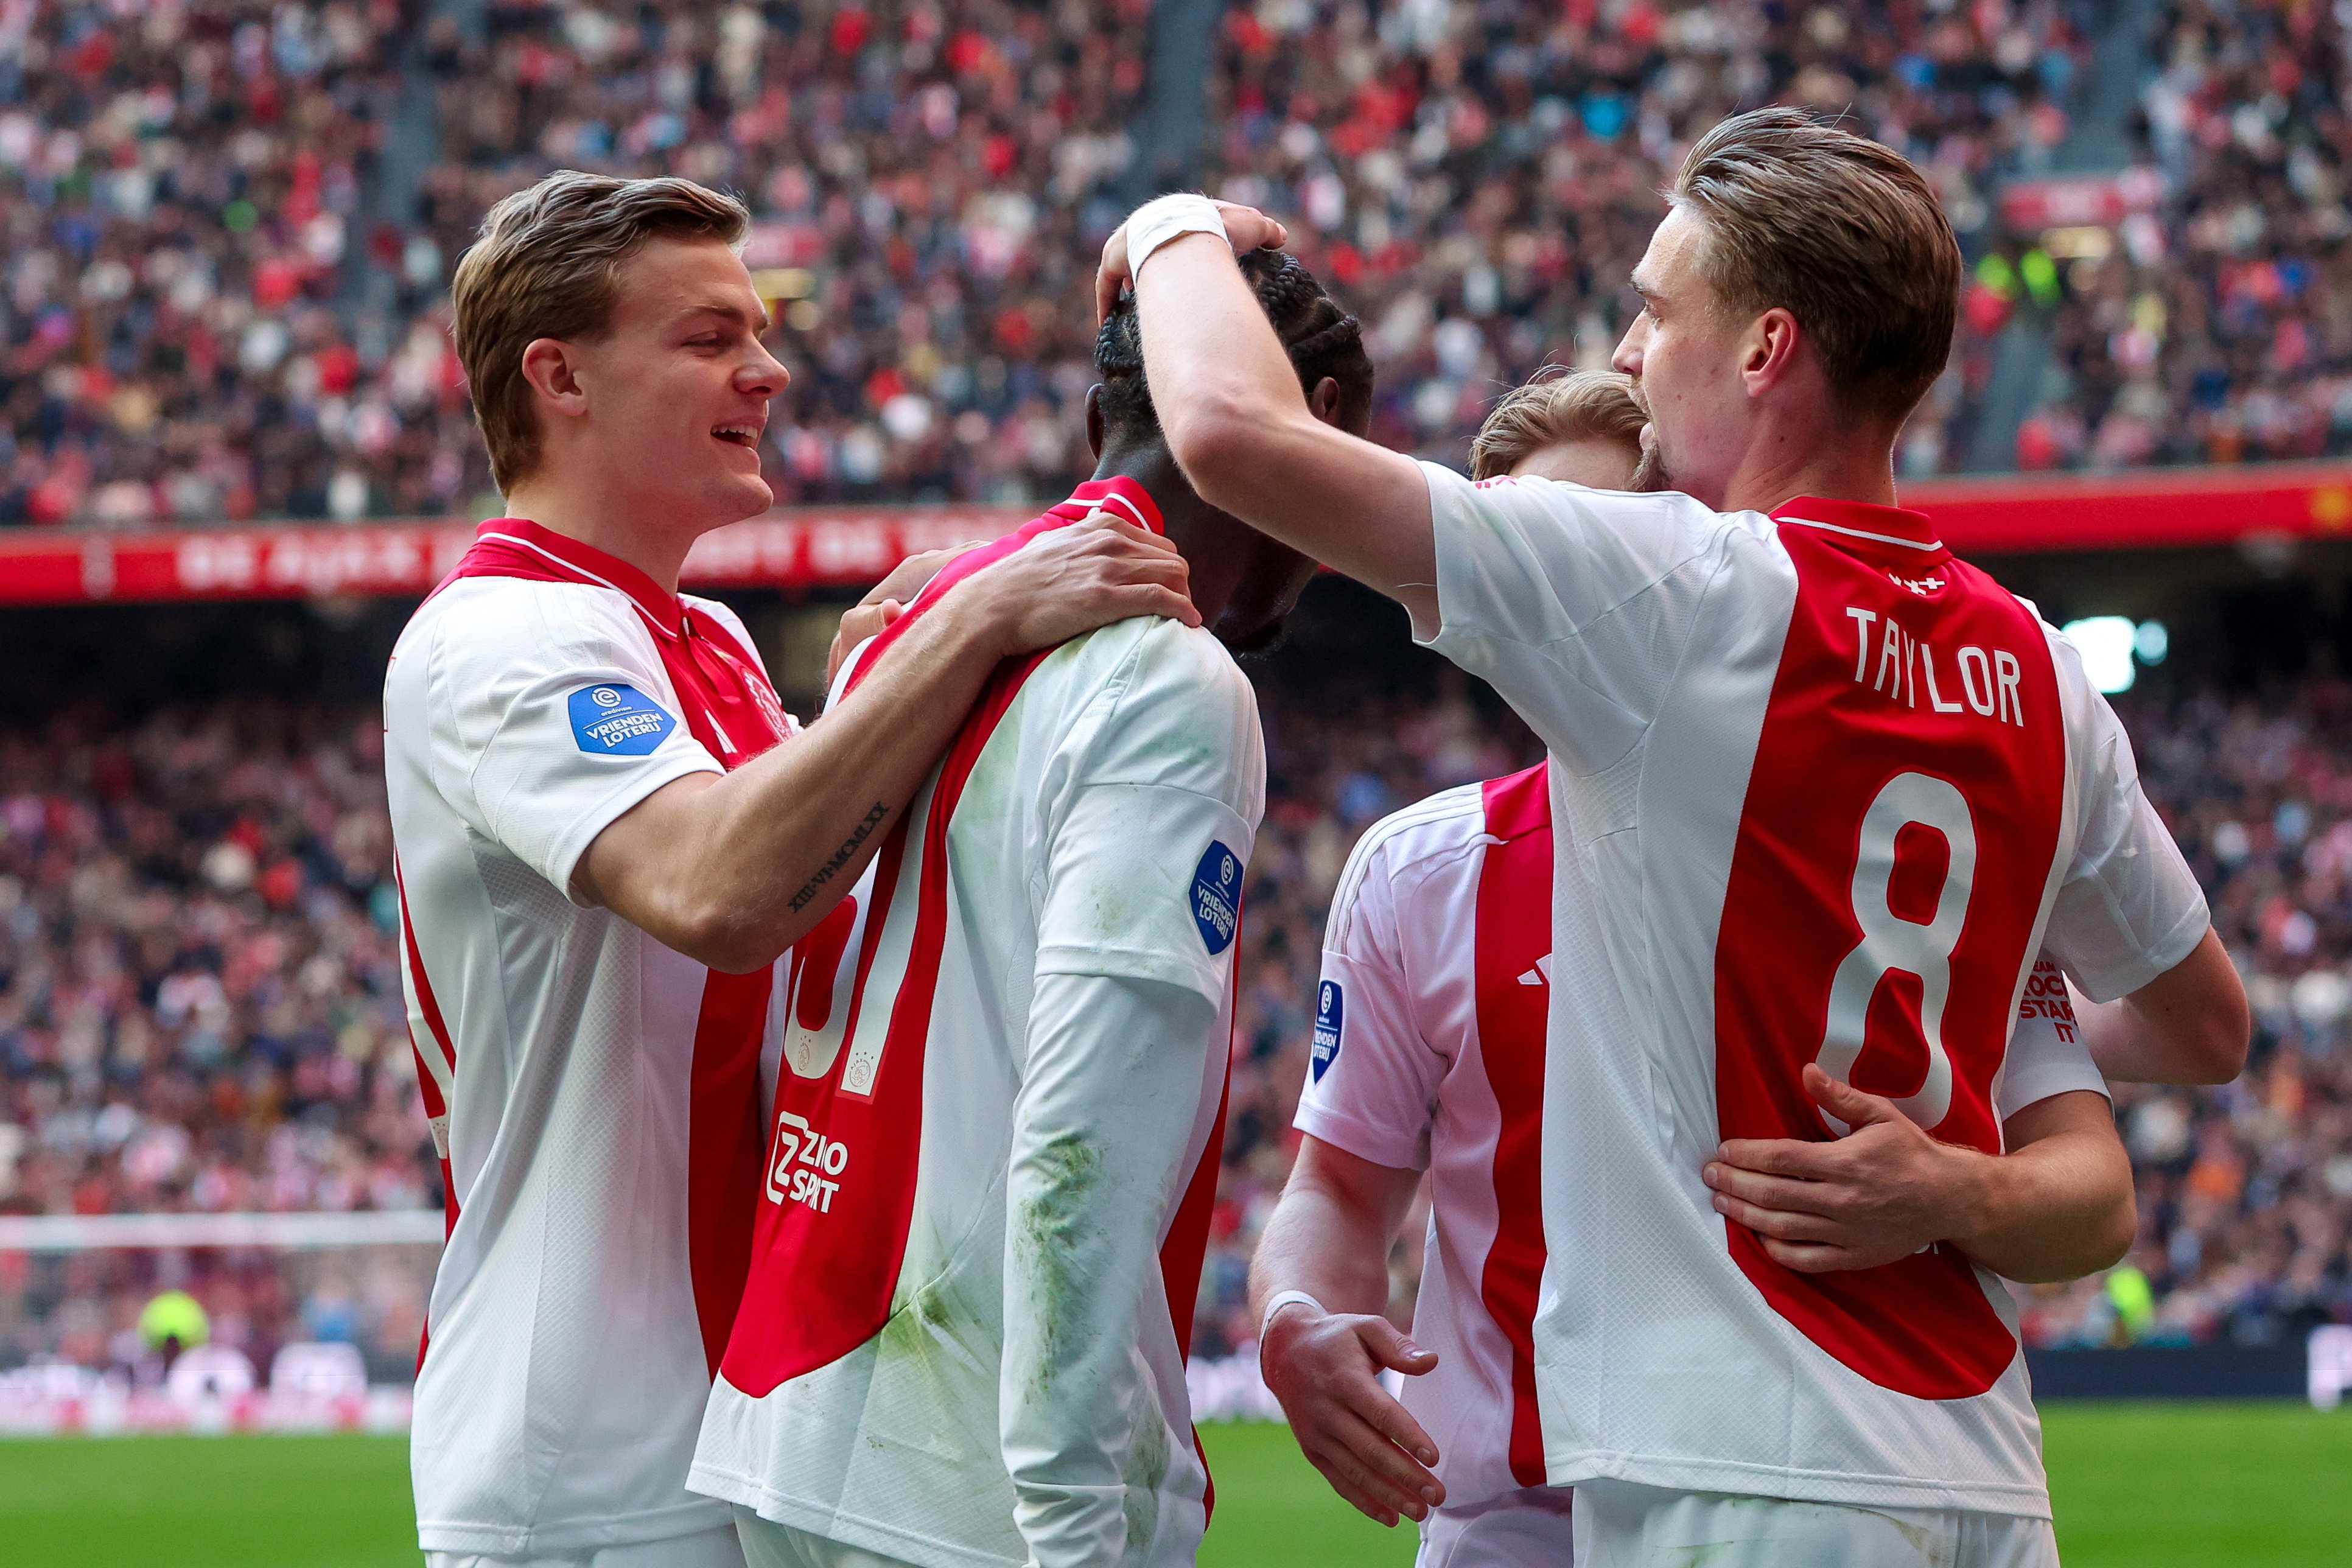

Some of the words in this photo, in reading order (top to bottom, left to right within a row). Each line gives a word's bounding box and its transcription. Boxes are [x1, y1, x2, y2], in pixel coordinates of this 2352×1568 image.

[1846, 606, 2025, 727] TAYLOR
[586, 713, 663, 740] VRIENDEN
[602, 722, 662, 748] LOTERIJ
[1197, 884, 1236, 930] VRIENDEN
[1199, 903, 1229, 940] LOTERIJ
[1815, 772, 1976, 1137] 8
[2033, 960, 2057, 973] EAM
[2024, 975, 2068, 998] OC
[2019, 999, 2078, 1027] STAR
[2054, 1022, 2075, 1044] IT
